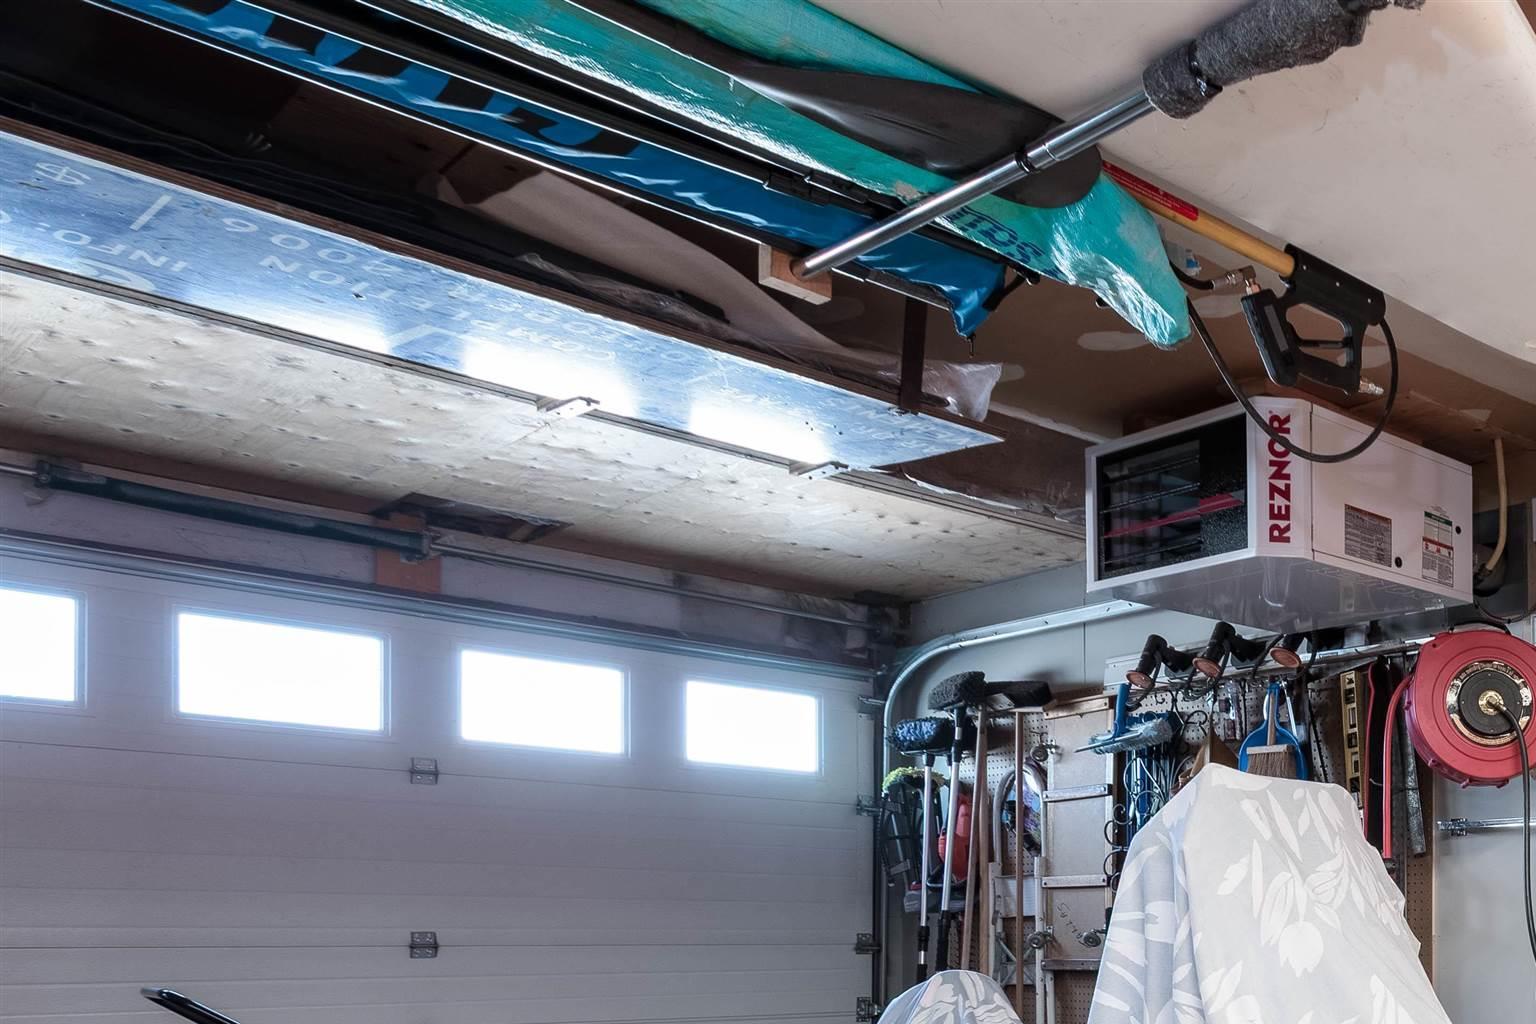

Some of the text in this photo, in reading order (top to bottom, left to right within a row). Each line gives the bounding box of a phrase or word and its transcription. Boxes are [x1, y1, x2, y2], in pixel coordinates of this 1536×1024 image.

[221, 216, 403, 279] 2006
[258, 254, 618, 362] COMPLETION
[1268, 413, 1291, 543] REZNOR
